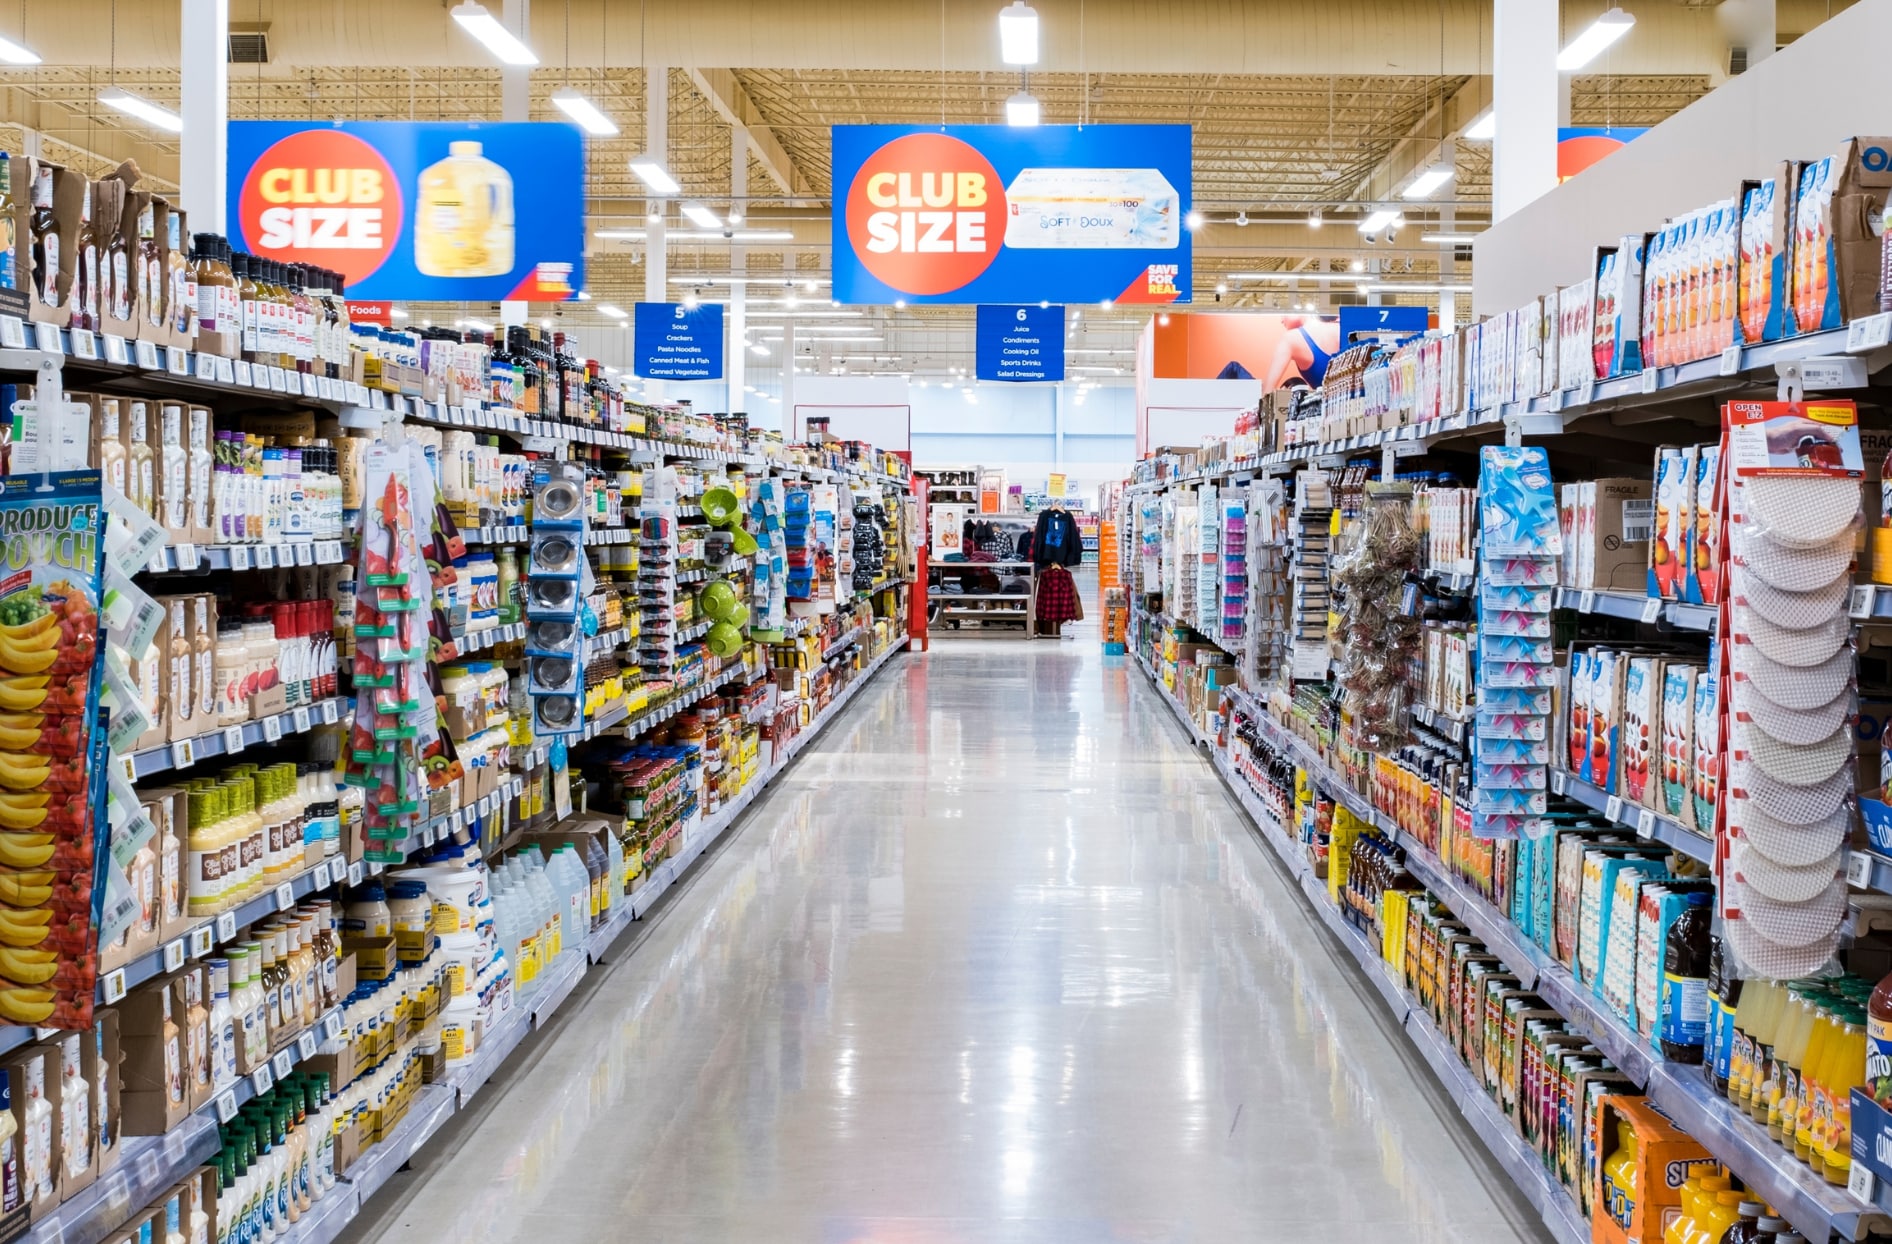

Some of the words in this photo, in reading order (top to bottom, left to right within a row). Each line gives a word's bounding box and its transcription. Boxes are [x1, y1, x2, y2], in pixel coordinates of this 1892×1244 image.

[259, 168, 384, 204] CLUB
[866, 172, 988, 208] CLUB
[258, 207, 383, 249] SIZE
[866, 211, 987, 254] SIZE
[1148, 264, 1178, 275] SAVE
[1148, 275, 1173, 285] FOR
[350, 305, 382, 315] Foods
[674, 306, 685, 319] 5
[1016, 309, 1027, 321] 6
[1379, 310, 1390, 323] 7
[1002, 348, 1029, 356] Cooking
[1000, 359, 1021, 367] Sports
[1015, 371, 1045, 379] Dressings
[1604, 486, 1639, 495] FRAGILE
[0, 504, 97, 536] RODUCE
